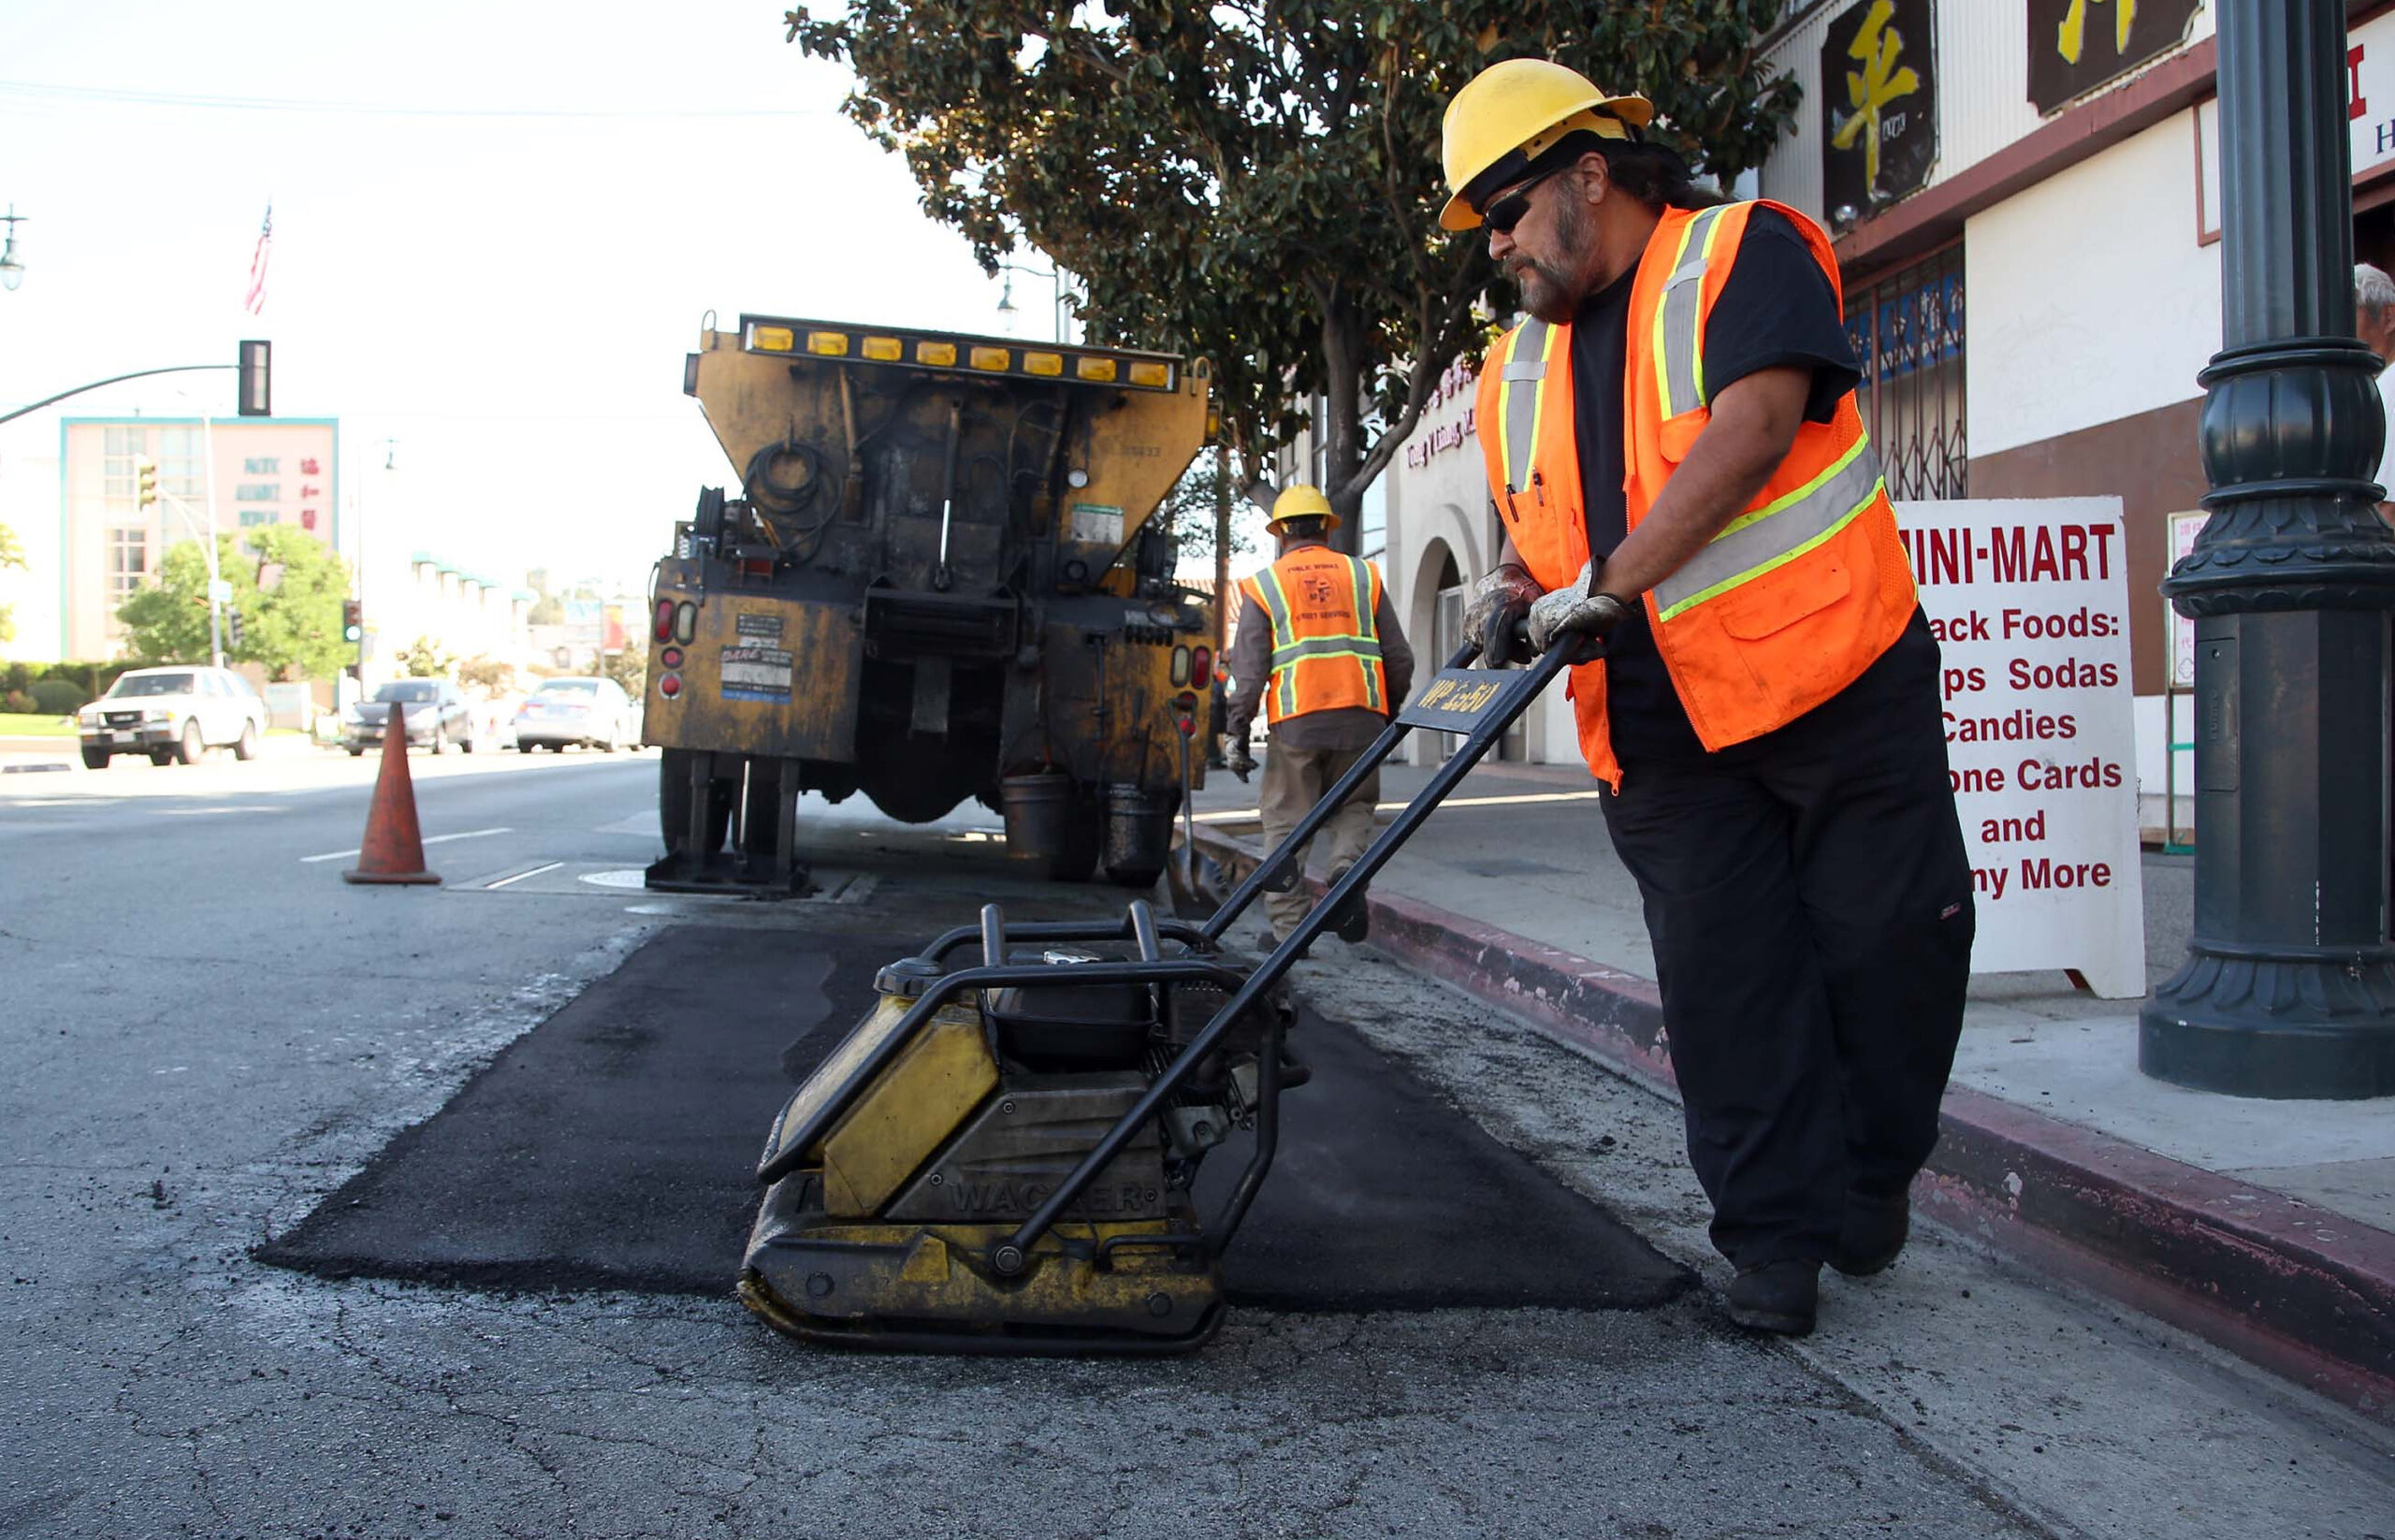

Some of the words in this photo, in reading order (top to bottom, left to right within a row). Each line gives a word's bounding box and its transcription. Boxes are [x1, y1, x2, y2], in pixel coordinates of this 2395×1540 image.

[1929, 610, 1990, 642] ack
[2002, 606, 2118, 640] Foods:
[1943, 667, 1986, 701] ps
[2009, 657, 2119, 690] Sodas
[1949, 767, 2005, 793] one
[2017, 757, 2123, 792] Cards
[1981, 809, 2046, 844] and
[1969, 867, 2009, 901] ny
[2021, 858, 2112, 890] More
[951, 1180, 1147, 1213] WACER
